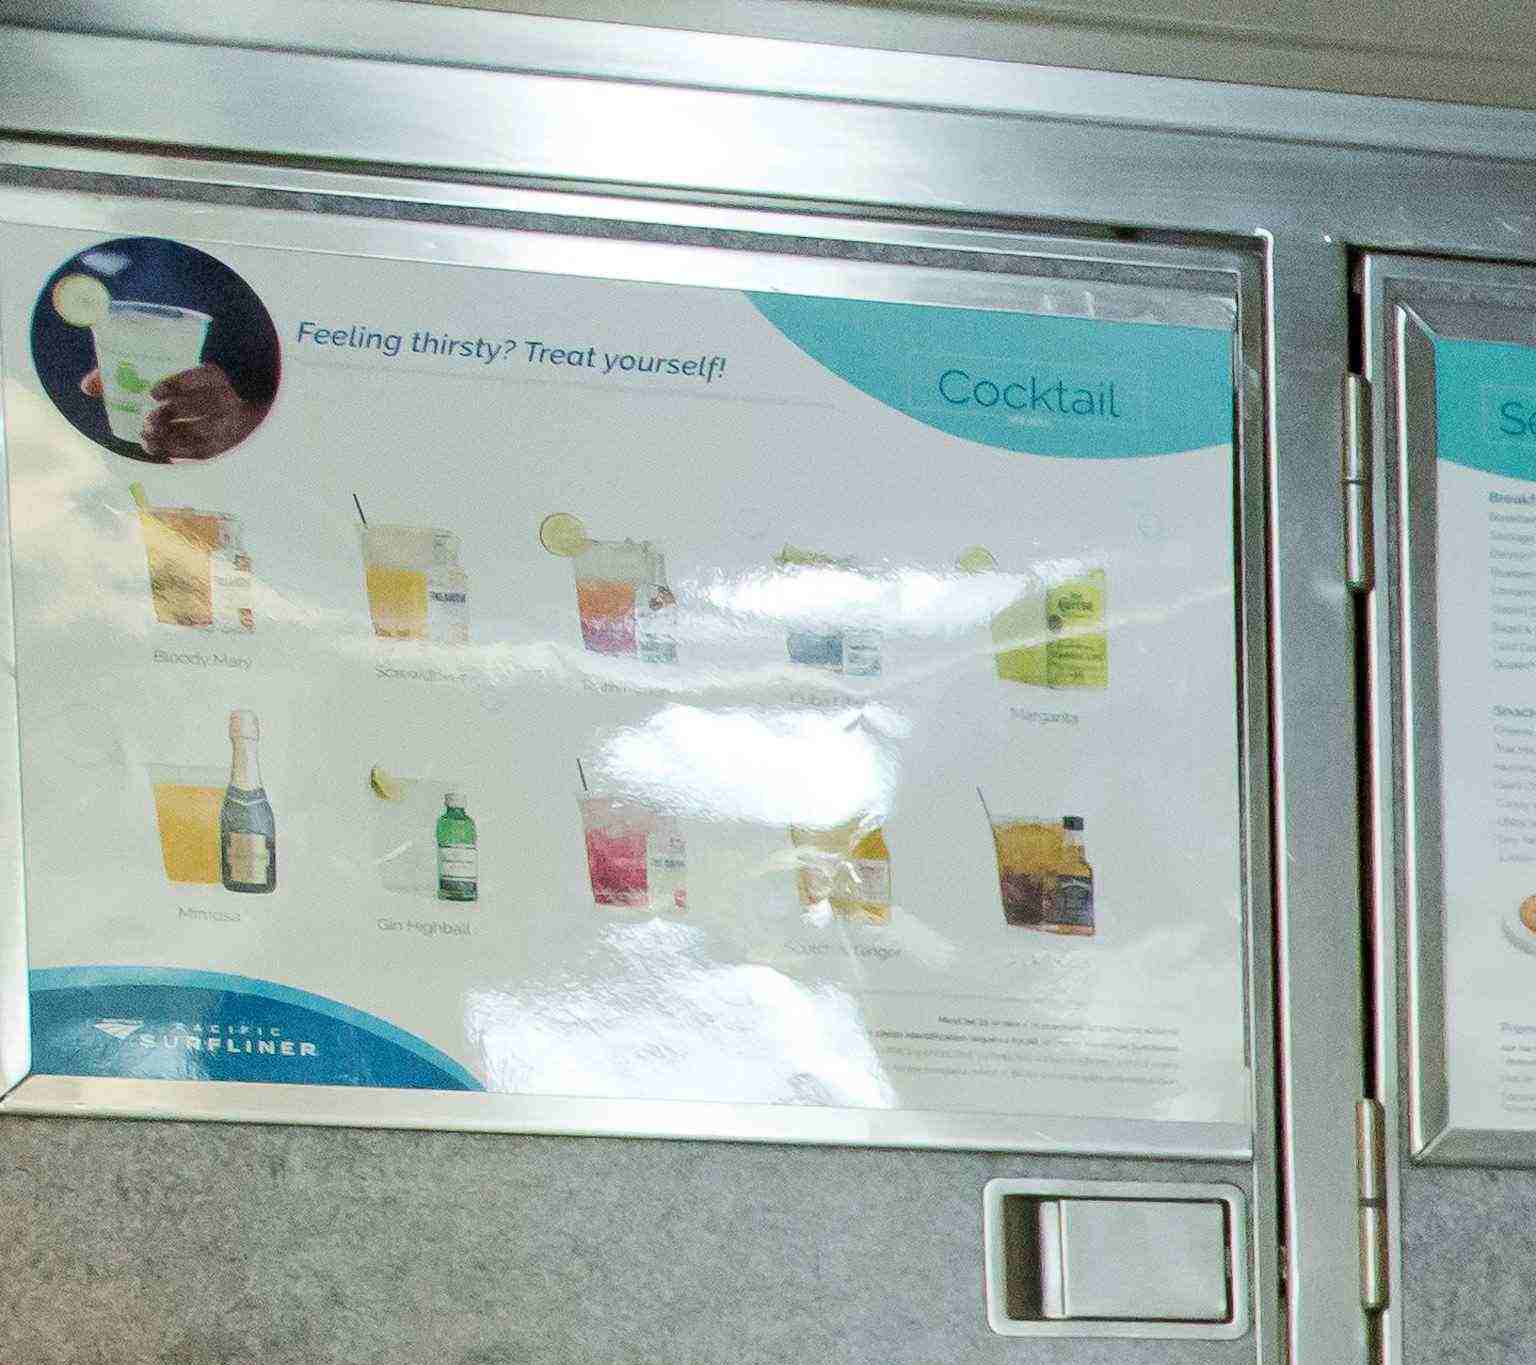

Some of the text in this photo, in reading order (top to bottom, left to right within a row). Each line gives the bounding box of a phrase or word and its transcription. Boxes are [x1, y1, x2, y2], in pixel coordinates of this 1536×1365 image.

[296, 320, 726, 382] Feeling thirsty? Treat yourself!
[937, 367, 1121, 420] Cocktail
[138, 1034, 318, 1058] SURFLINER
